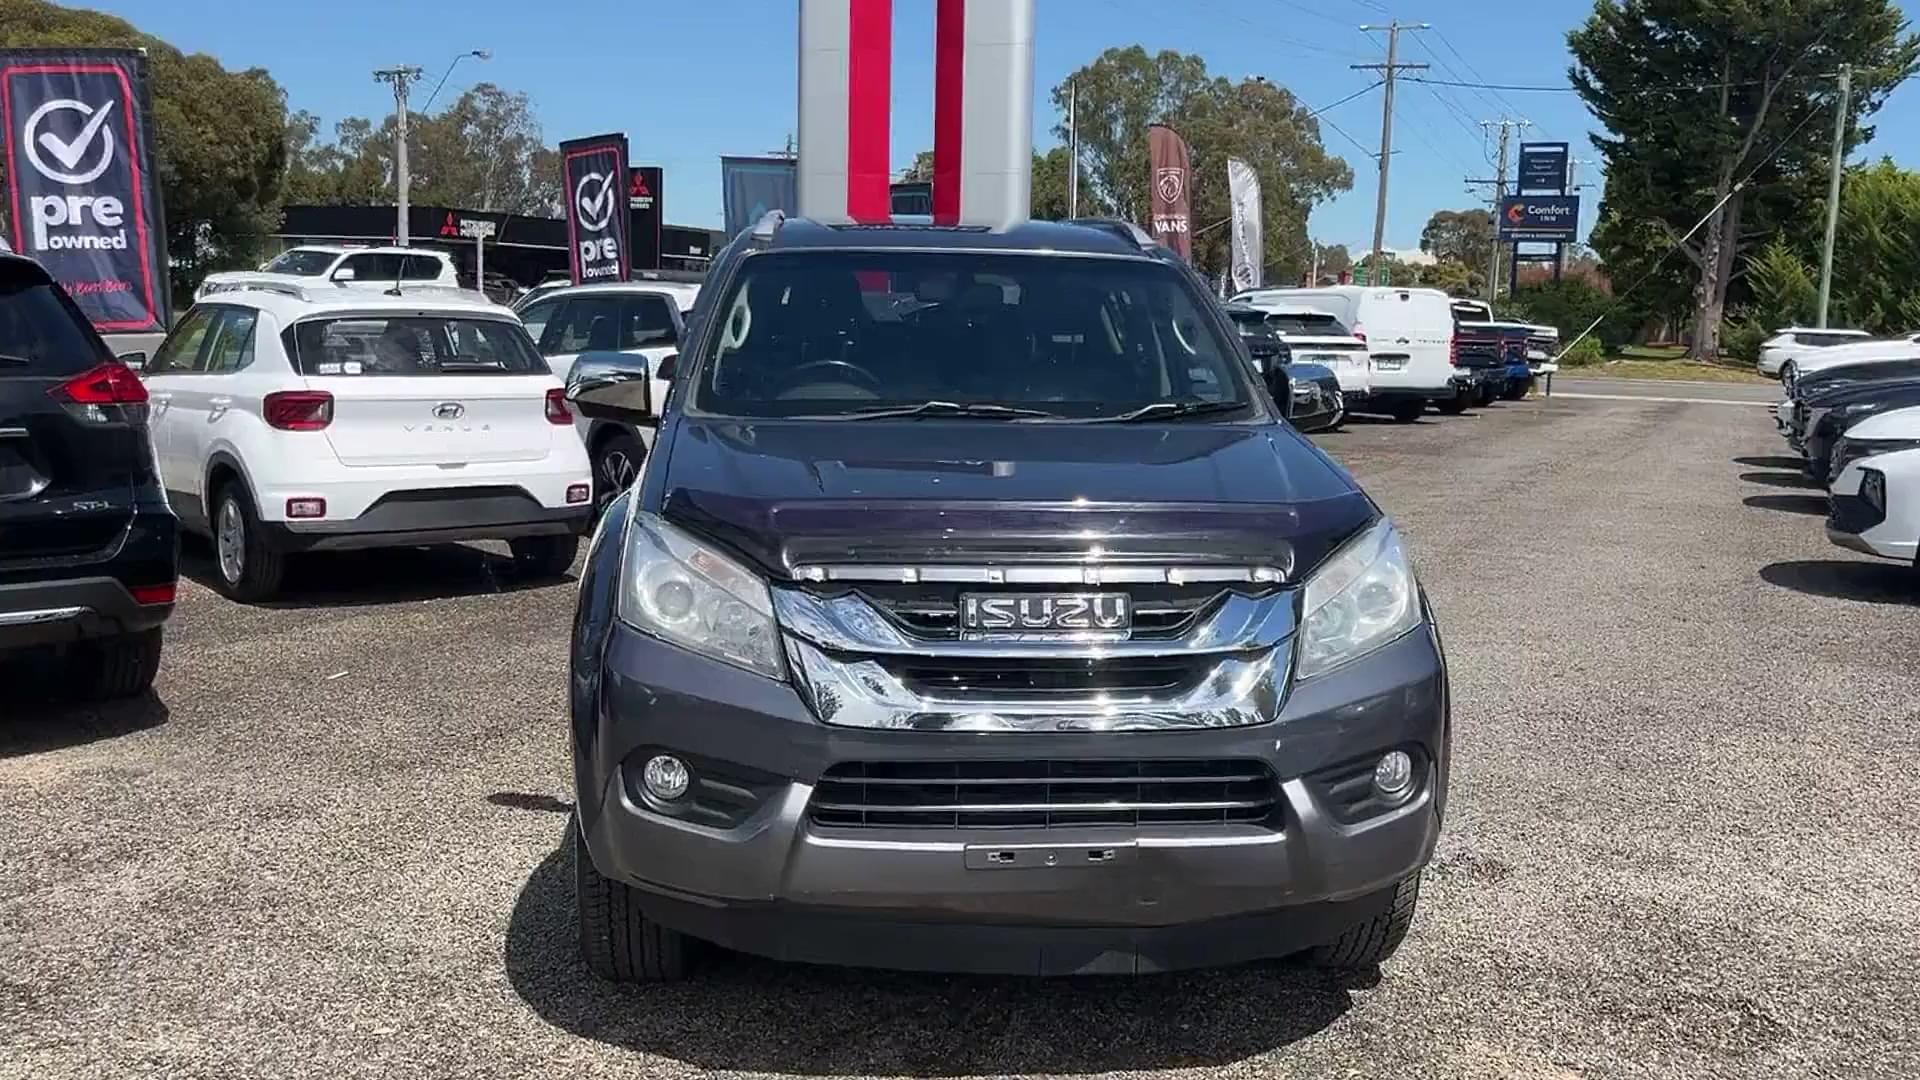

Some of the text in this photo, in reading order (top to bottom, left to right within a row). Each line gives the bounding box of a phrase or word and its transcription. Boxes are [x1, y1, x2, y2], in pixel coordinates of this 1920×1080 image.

[30, 194, 125, 250] pre
[1527, 205, 1570, 215] Comfort
[49, 228, 128, 250] owned
[1154, 220, 1188, 233] VANS
[579, 236, 619, 279] pre
[966, 597, 1125, 629] ISUZU
